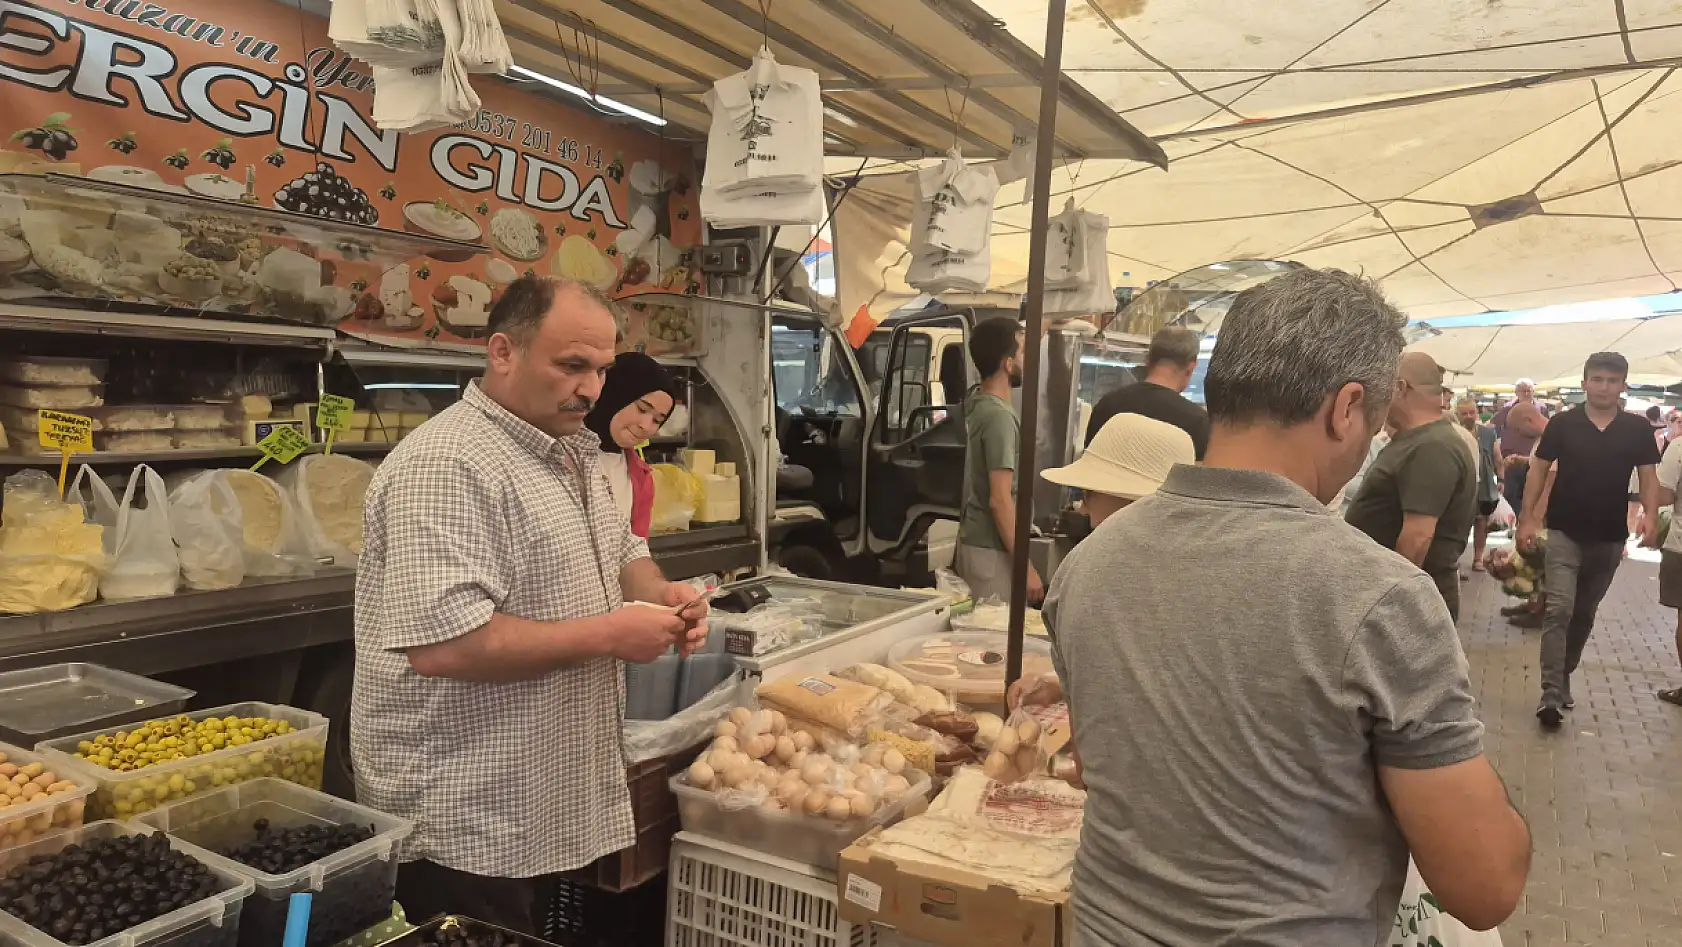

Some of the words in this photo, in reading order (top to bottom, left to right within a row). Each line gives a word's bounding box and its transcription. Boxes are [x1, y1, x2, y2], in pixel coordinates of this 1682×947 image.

[307, 47, 376, 95] Yer
[468, 109, 517, 142] 0537
[521, 123, 552, 154] 201
[557, 136, 580, 162] 46
[584, 144, 603, 170] 14
[429, 132, 628, 229] GIDA
